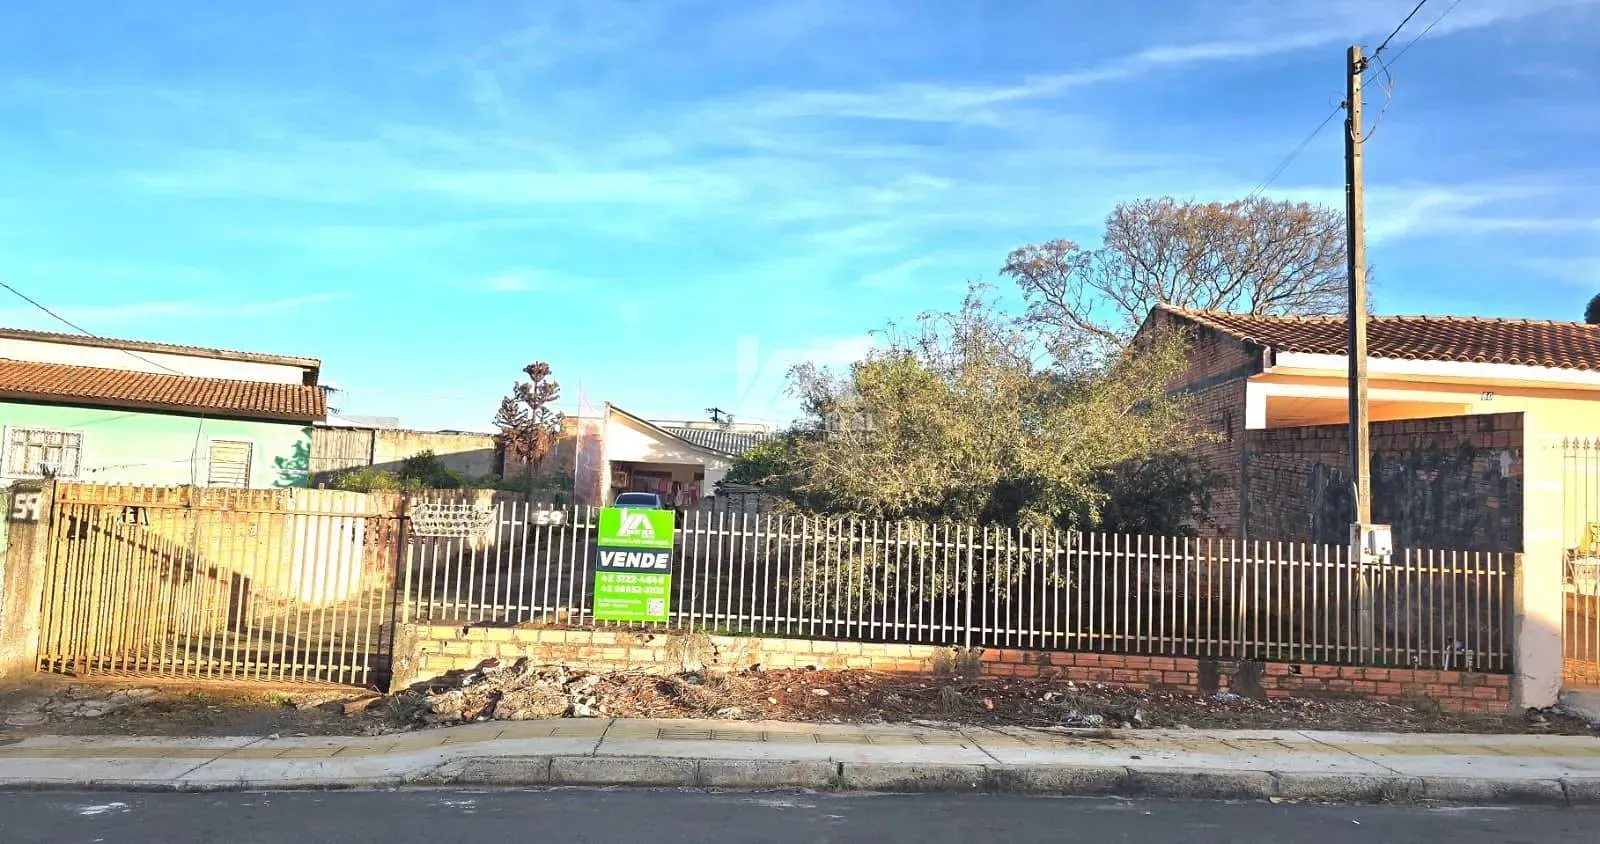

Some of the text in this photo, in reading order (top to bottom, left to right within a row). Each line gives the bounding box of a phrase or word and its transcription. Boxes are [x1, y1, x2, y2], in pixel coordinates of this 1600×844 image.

[13, 492, 42, 520] 59
[536, 509, 563, 526] 59
[600, 551, 669, 568] VENDE
[601, 574, 614, 583] 42
[600, 585, 613, 593] 42
